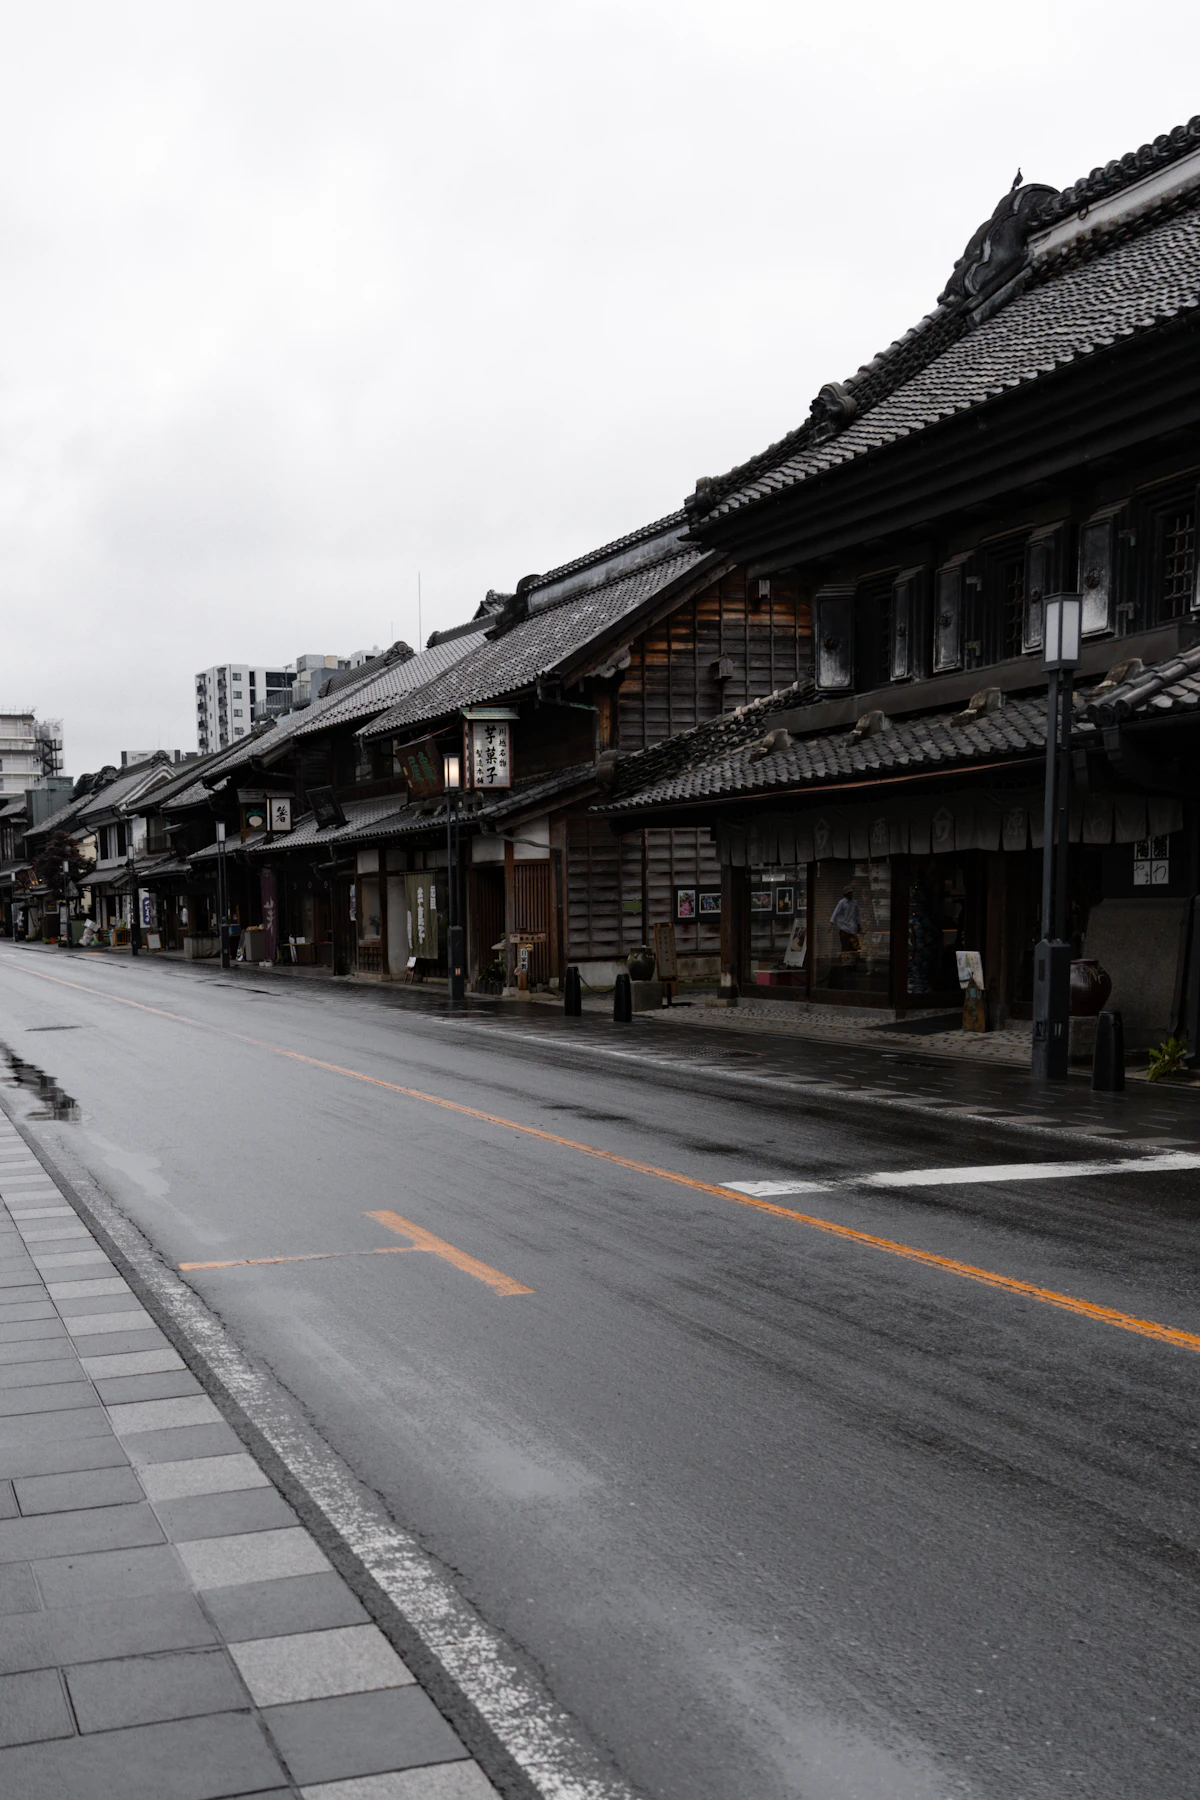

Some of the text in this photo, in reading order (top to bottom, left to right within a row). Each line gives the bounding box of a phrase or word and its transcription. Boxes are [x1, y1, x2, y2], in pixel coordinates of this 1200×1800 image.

[484, 725, 498, 784] 芋菓子
[498, 727, 507, 767] 川越名物
[274, 805, 288, 823] 箸
